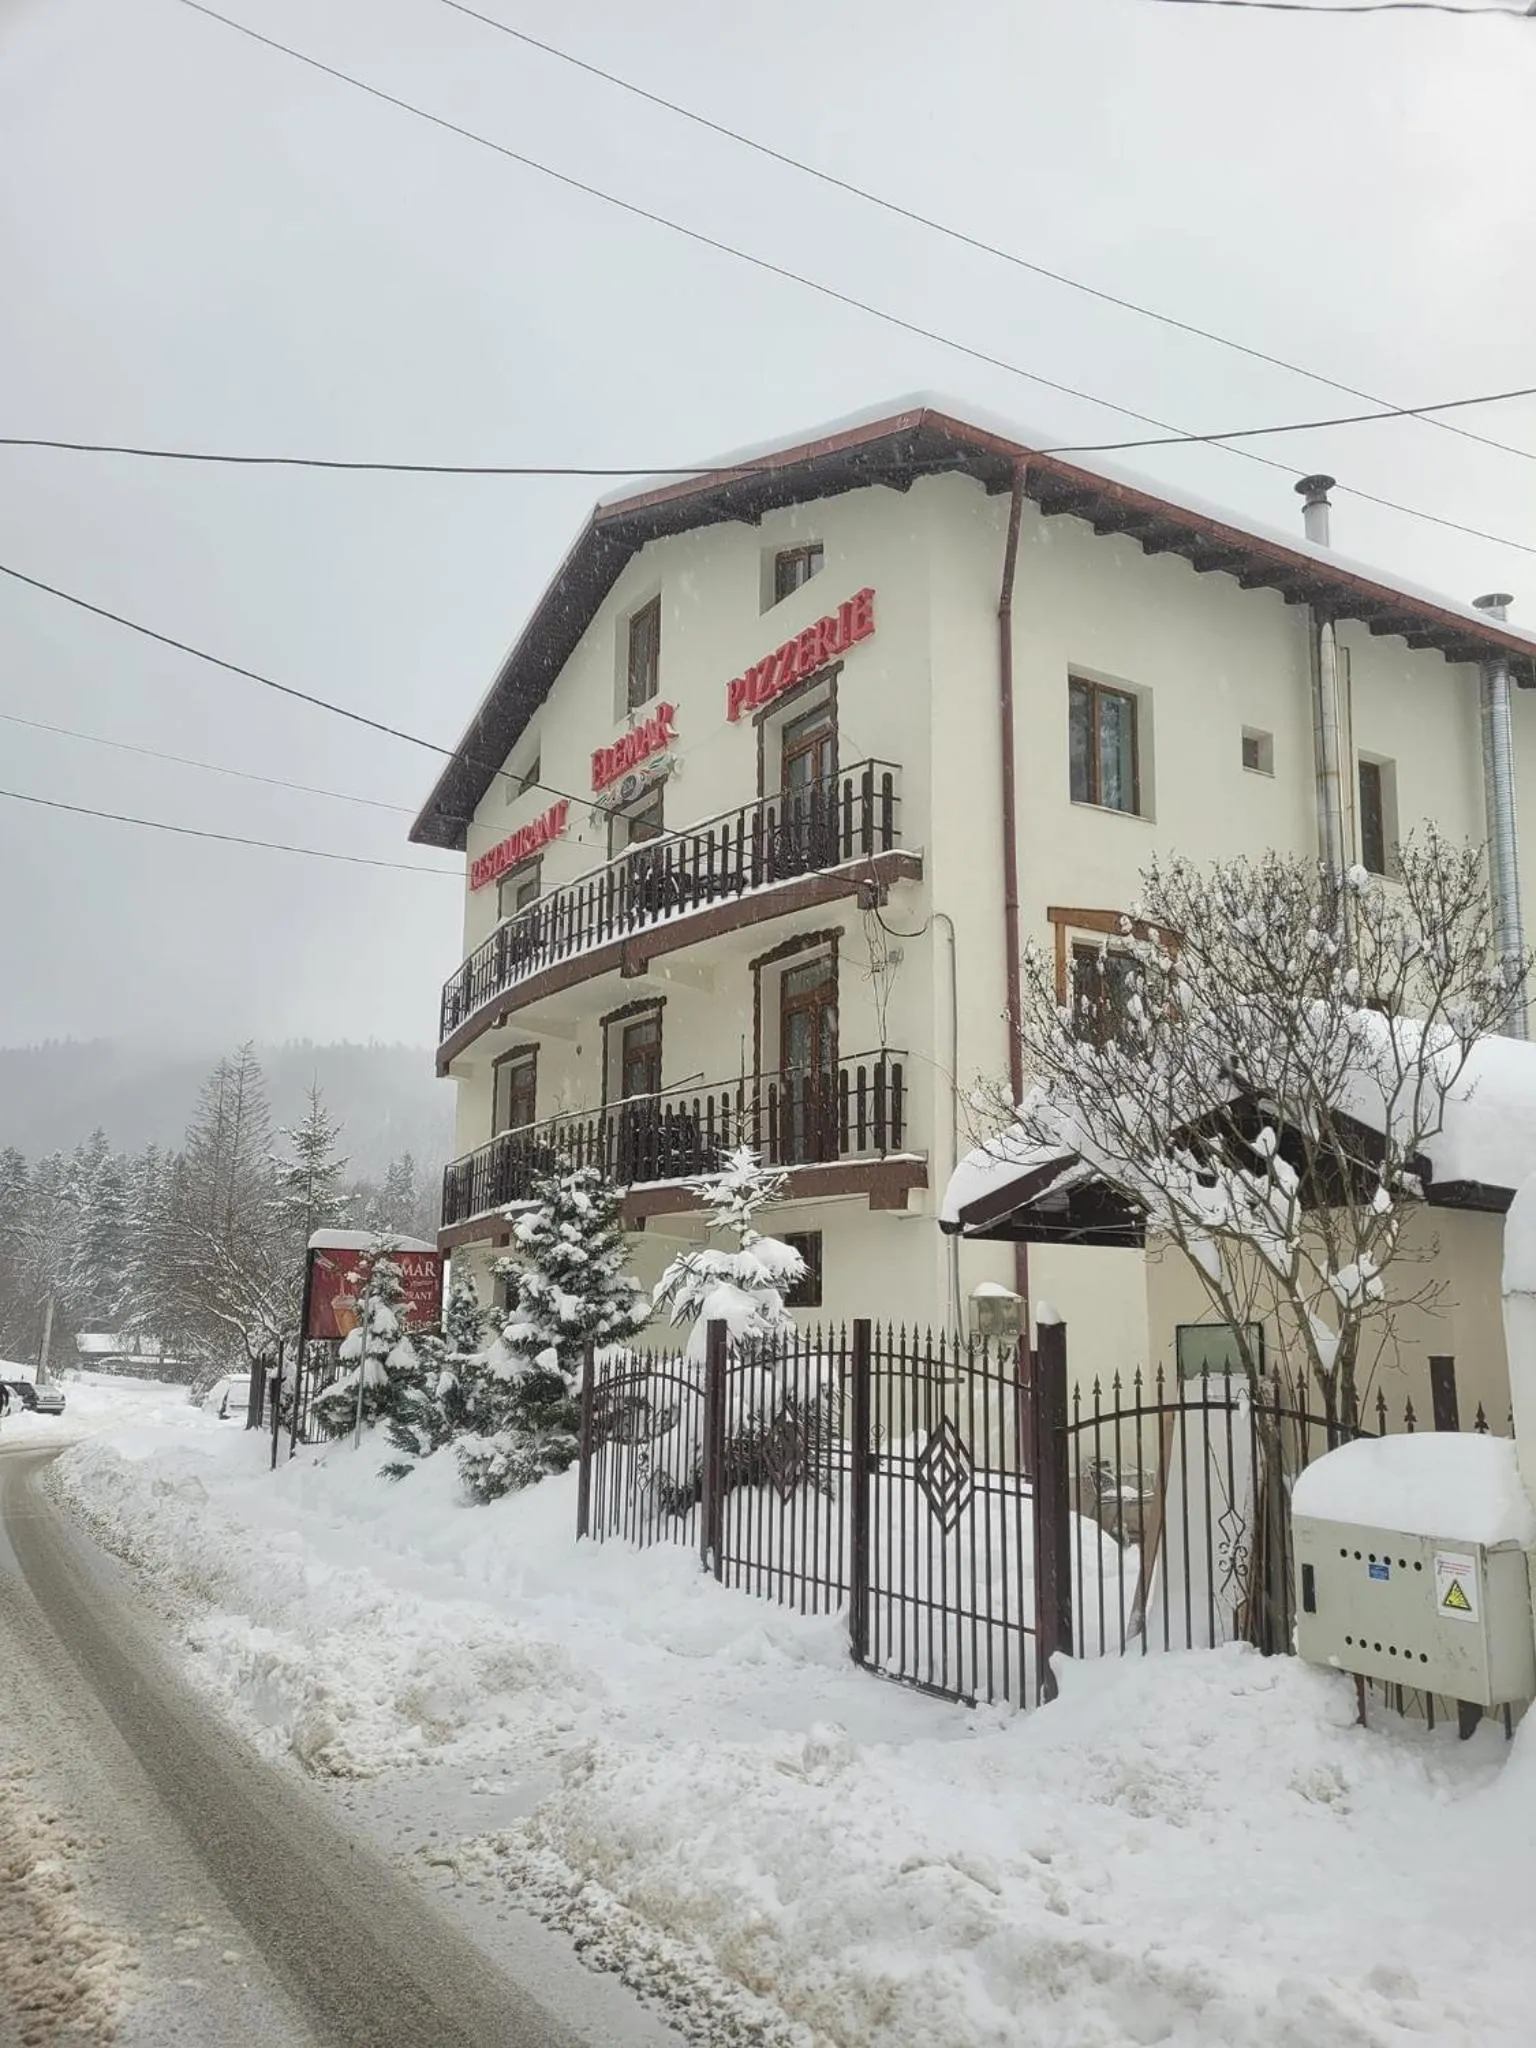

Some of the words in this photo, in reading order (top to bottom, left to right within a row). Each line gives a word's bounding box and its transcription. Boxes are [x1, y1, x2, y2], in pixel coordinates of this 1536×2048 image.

[726, 587, 876, 722] PIZZERIE
[470, 799, 569, 891] RESTAURANT
[402, 1261, 437, 1278] MAR
